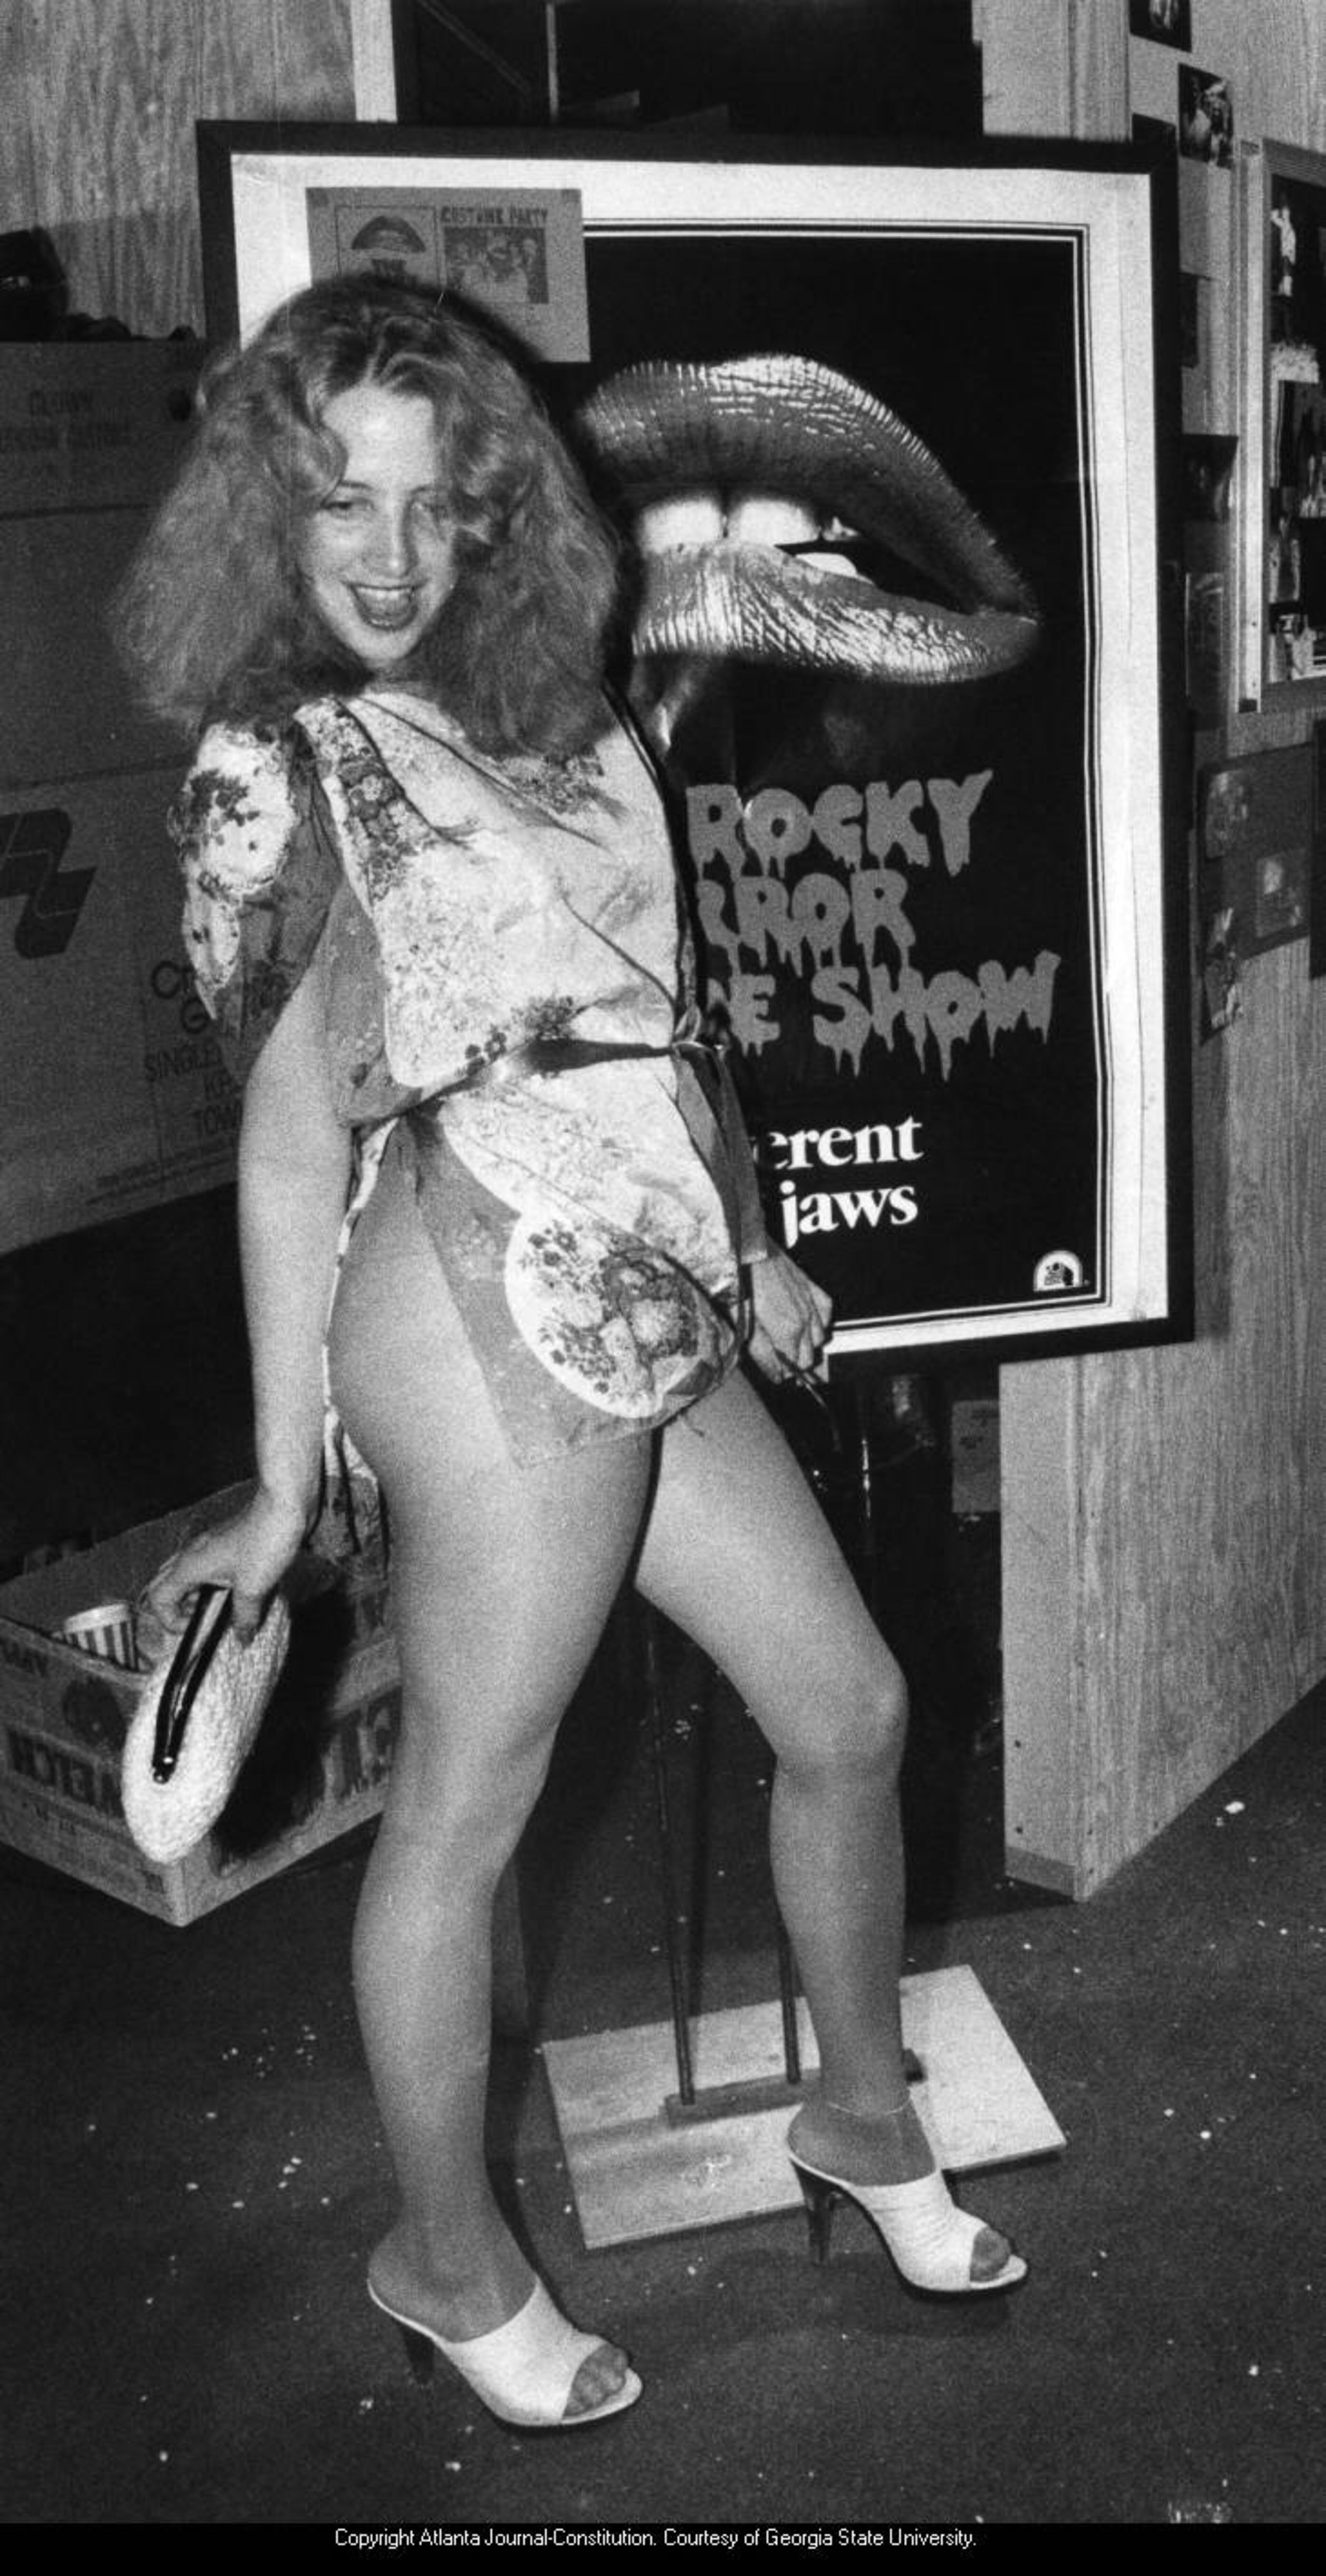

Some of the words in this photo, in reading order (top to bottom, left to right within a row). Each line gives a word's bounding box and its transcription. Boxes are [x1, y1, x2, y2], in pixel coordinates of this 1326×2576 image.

[509, 206, 548, 224] PARTY
[686, 769, 993, 881] ROCKY
[810, 949, 1061, 1082] SHOW
[780, 1180, 918, 1249] jaws
